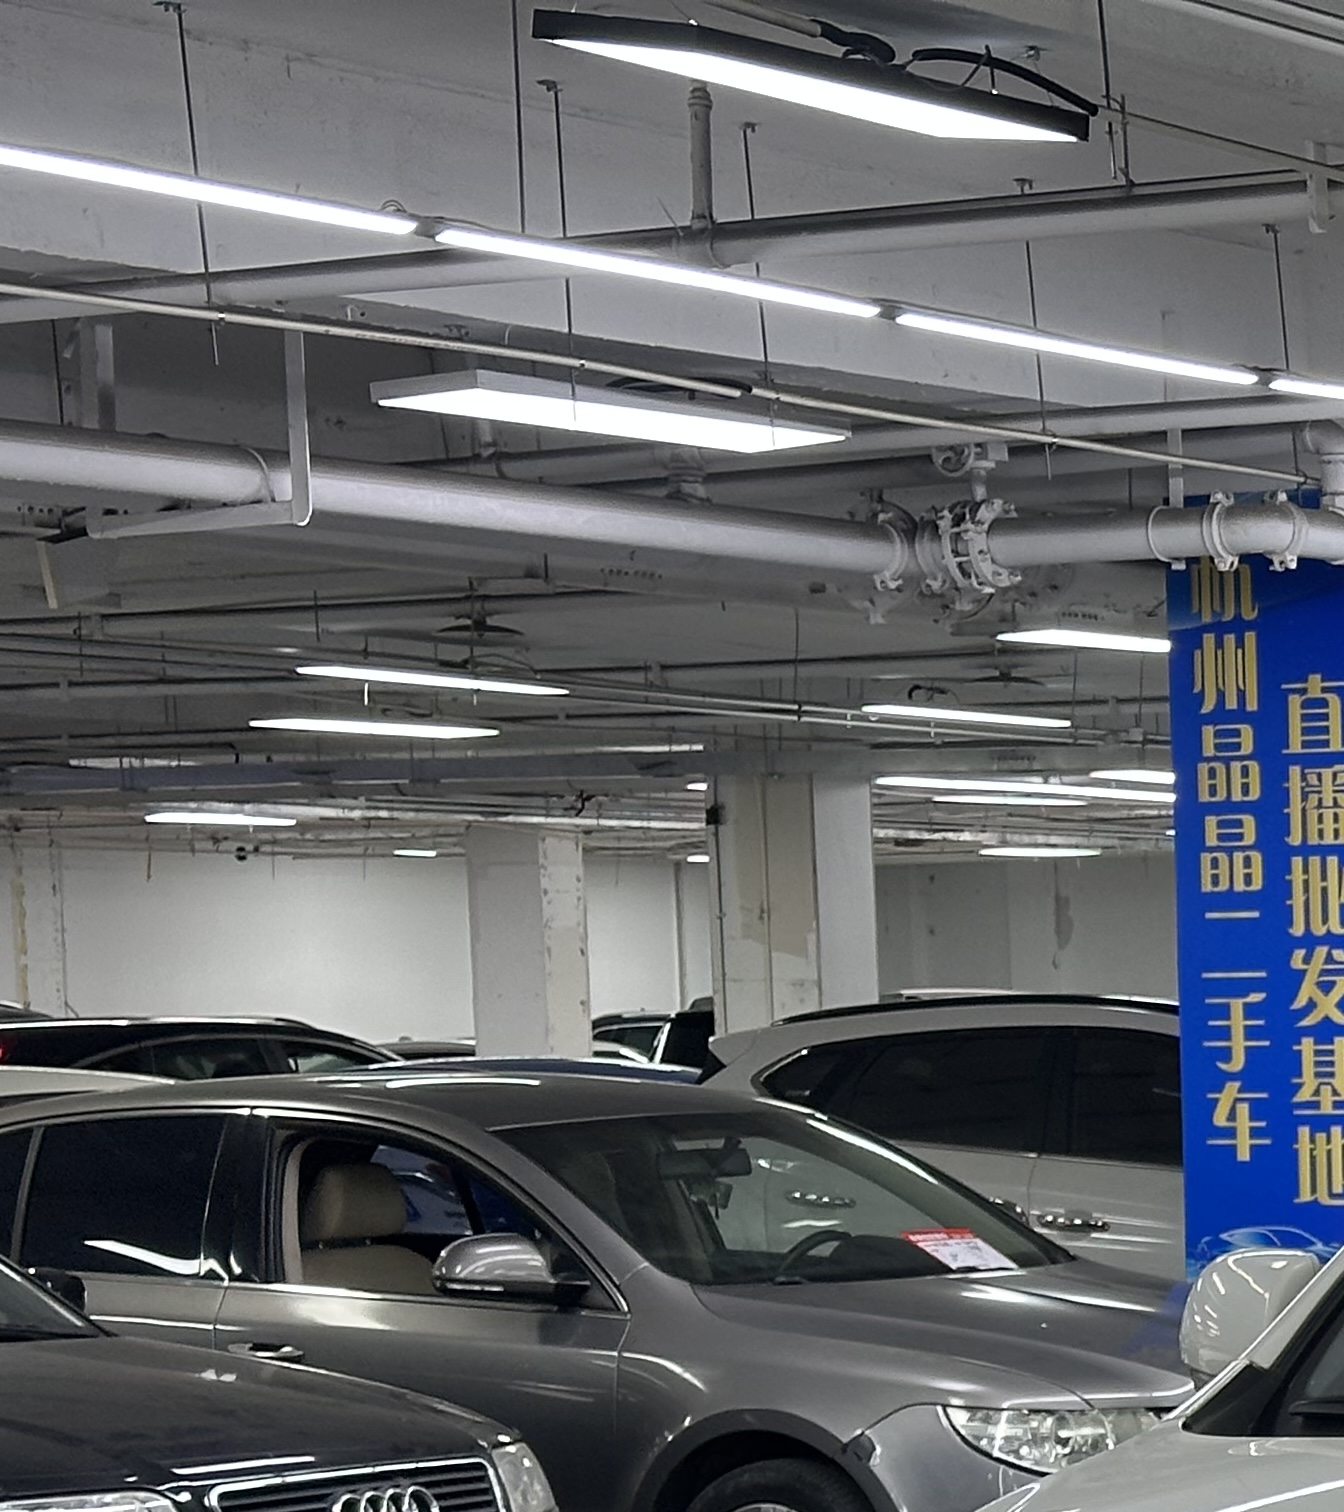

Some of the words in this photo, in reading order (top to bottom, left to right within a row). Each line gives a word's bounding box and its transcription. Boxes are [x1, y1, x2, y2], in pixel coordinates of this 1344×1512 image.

[1190, 556, 1271, 1163] 杭州晶晶二手车
